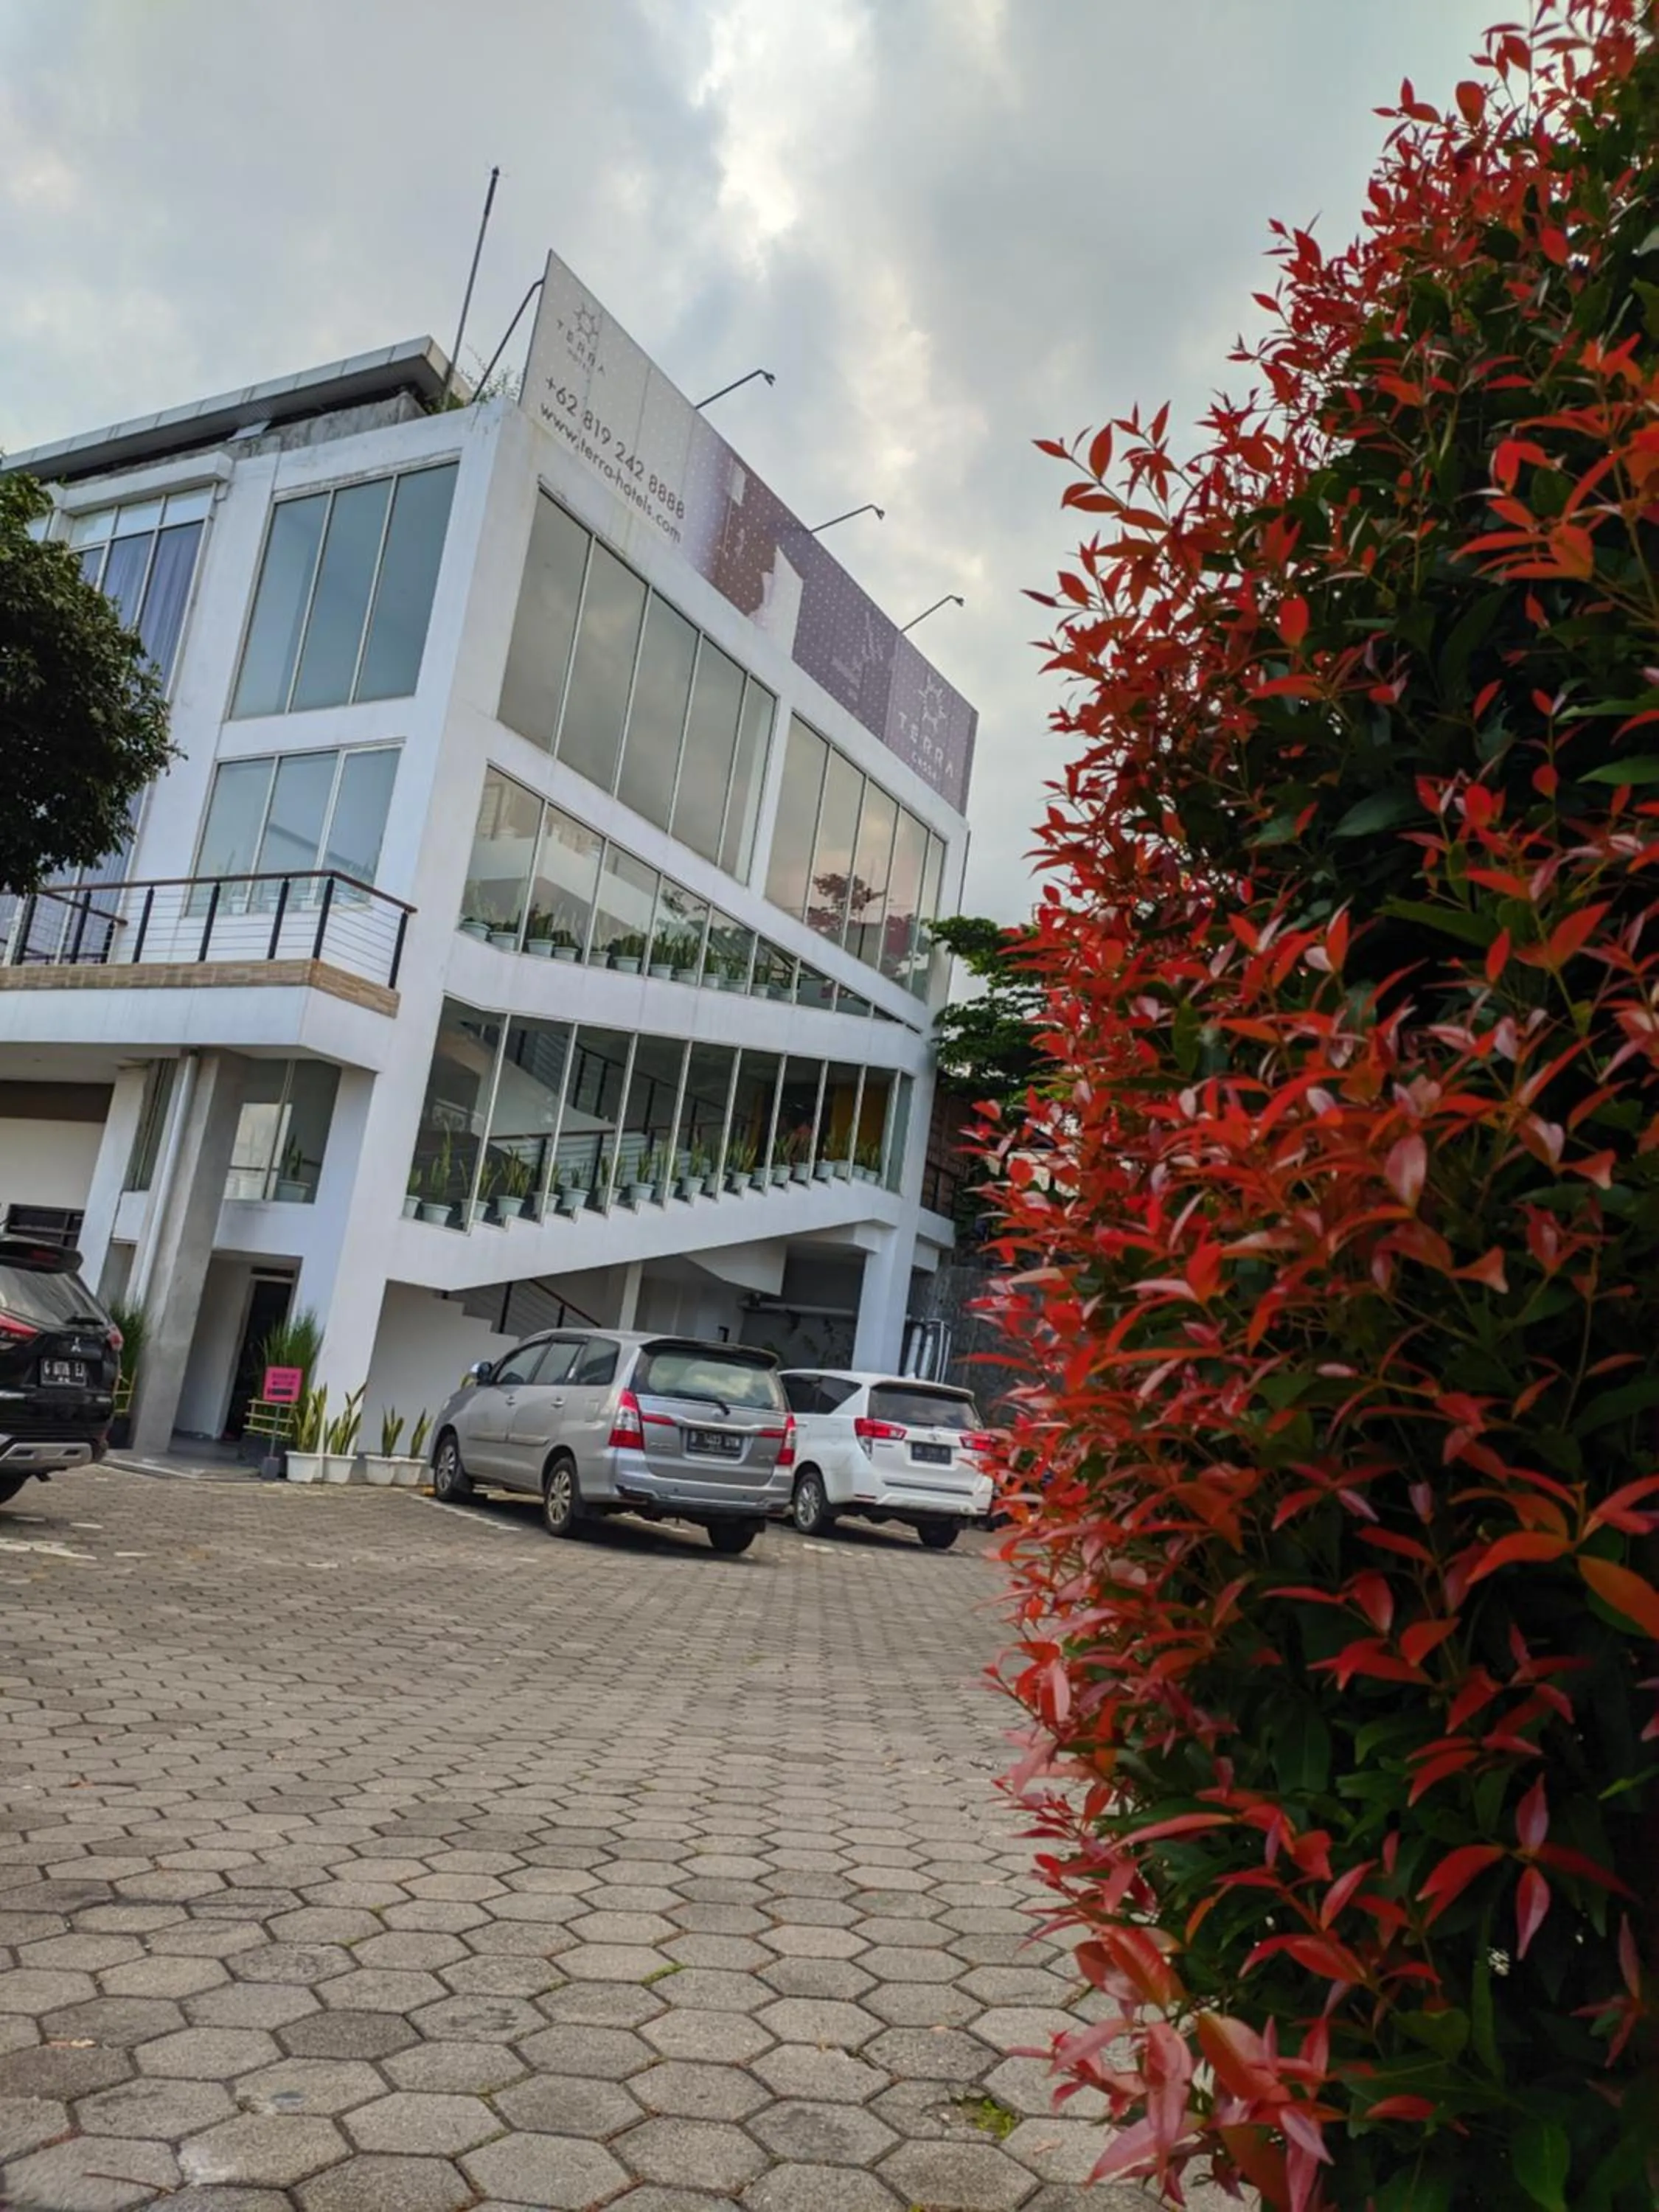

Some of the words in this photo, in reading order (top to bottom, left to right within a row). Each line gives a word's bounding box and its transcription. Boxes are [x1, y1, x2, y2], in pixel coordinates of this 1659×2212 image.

[557, 318, 606, 376] TERRA
[540, 402, 681, 543] www.terra-hotels.com
[546, 376, 578, 417] +62
[582, 409, 611, 445] 819
[614, 441, 644, 481] 242
[648, 474, 684, 520] 8888
[898, 712, 954, 779] TERRA
